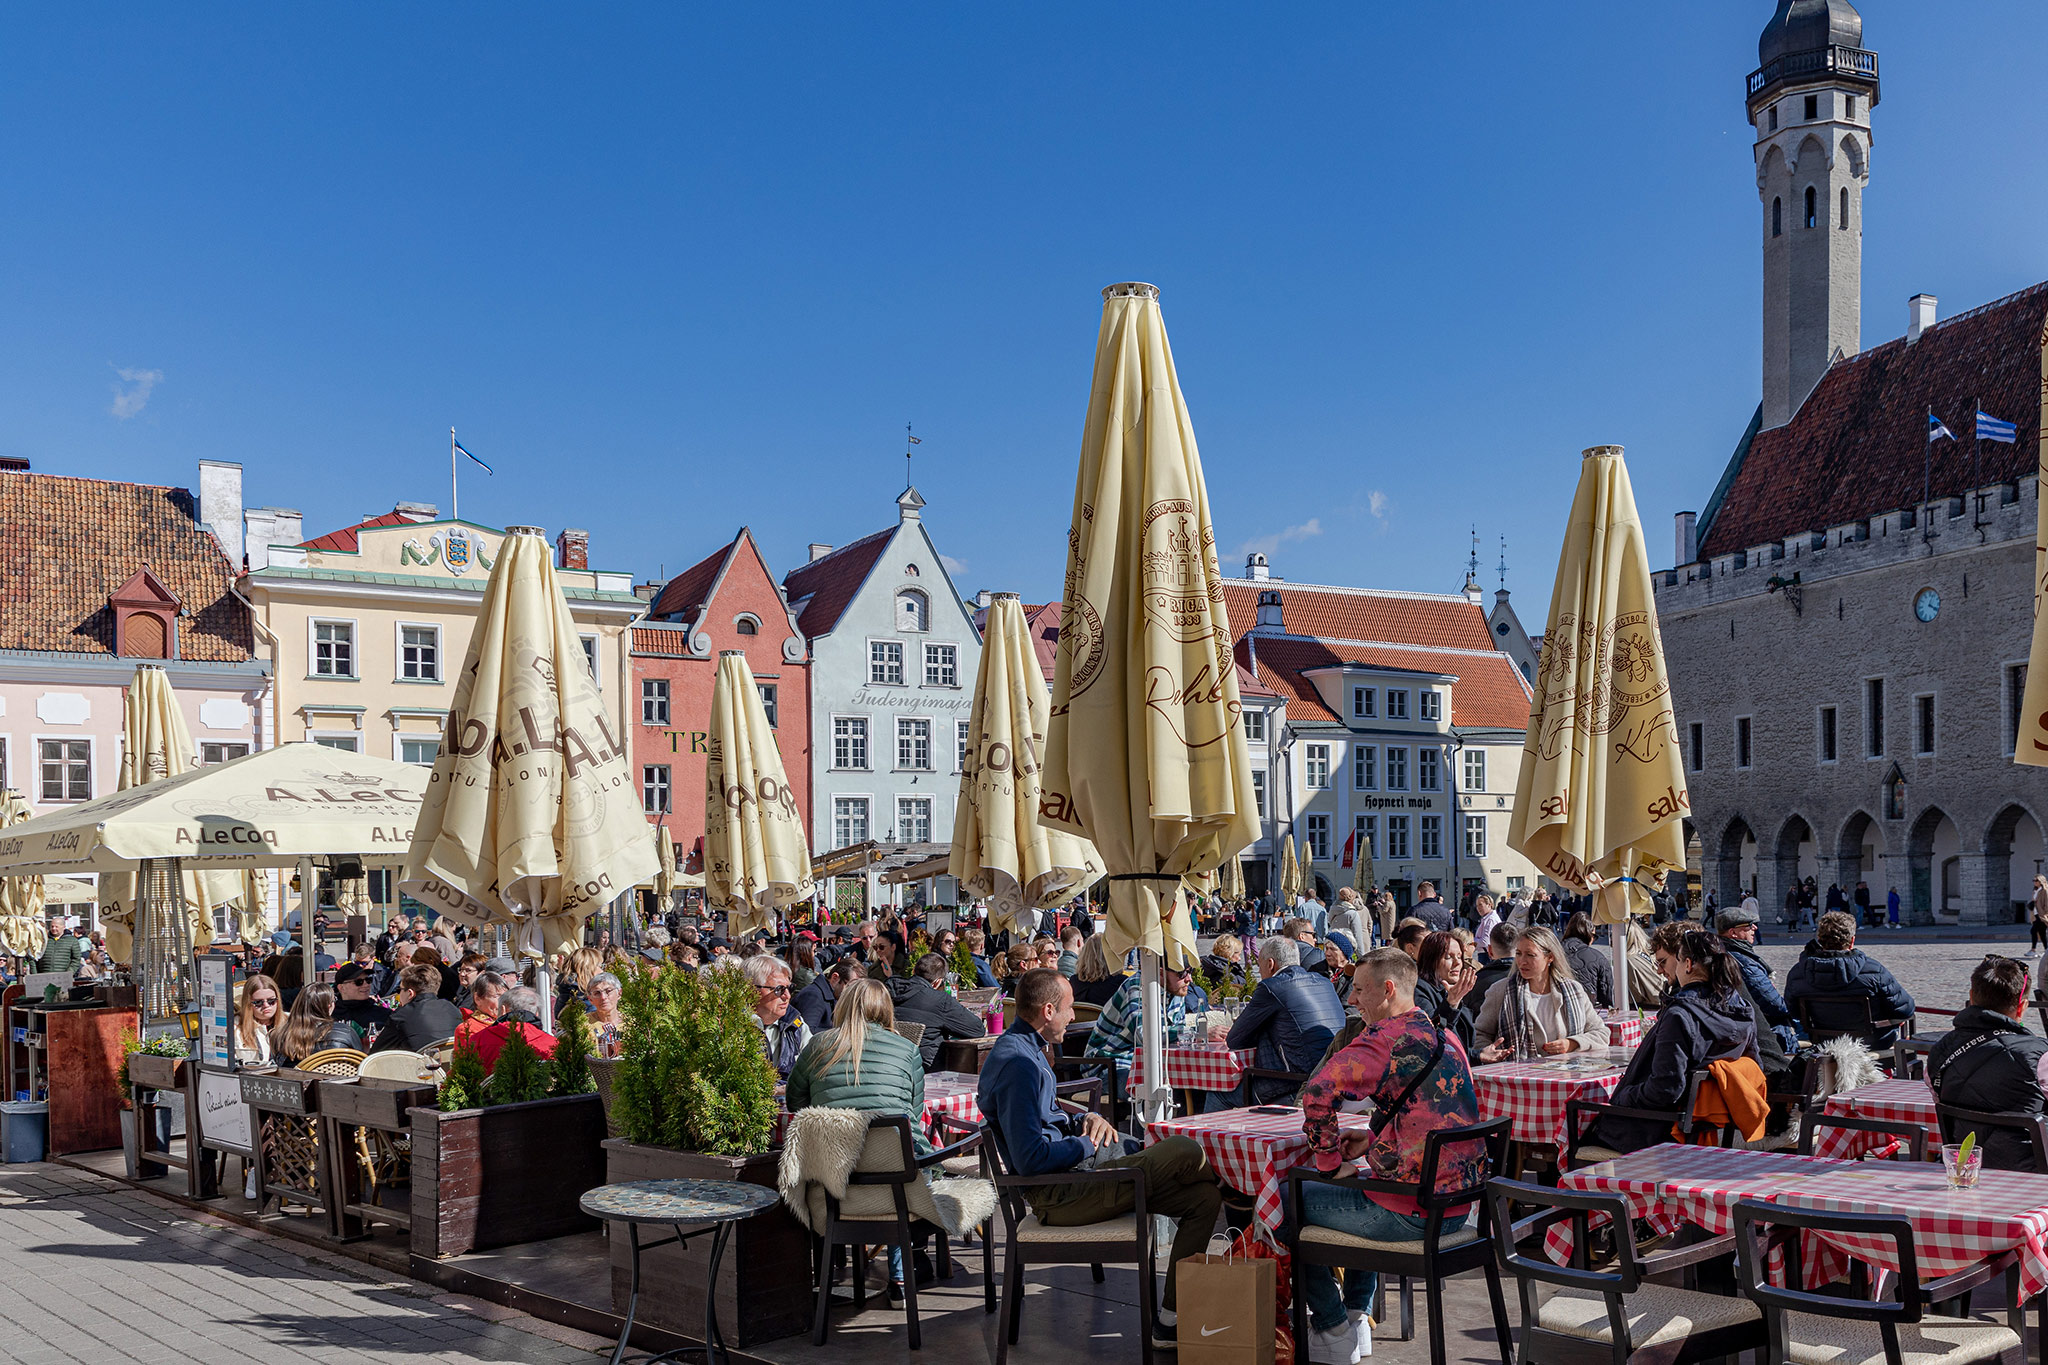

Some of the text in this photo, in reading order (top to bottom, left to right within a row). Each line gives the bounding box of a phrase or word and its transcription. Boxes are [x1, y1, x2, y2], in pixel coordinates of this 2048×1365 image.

[1169, 598, 1207, 613] RIGA
[1173, 615, 1201, 626] 1883
[851, 688, 972, 716] Tudengimaja
[664, 731, 709, 753] TR
[265, 787, 424, 803] A.LeC
[1365, 794, 1432, 811] Hopneri maja
[1648, 785, 1691, 824] sak
[175, 826, 279, 847] A.LeCoq
